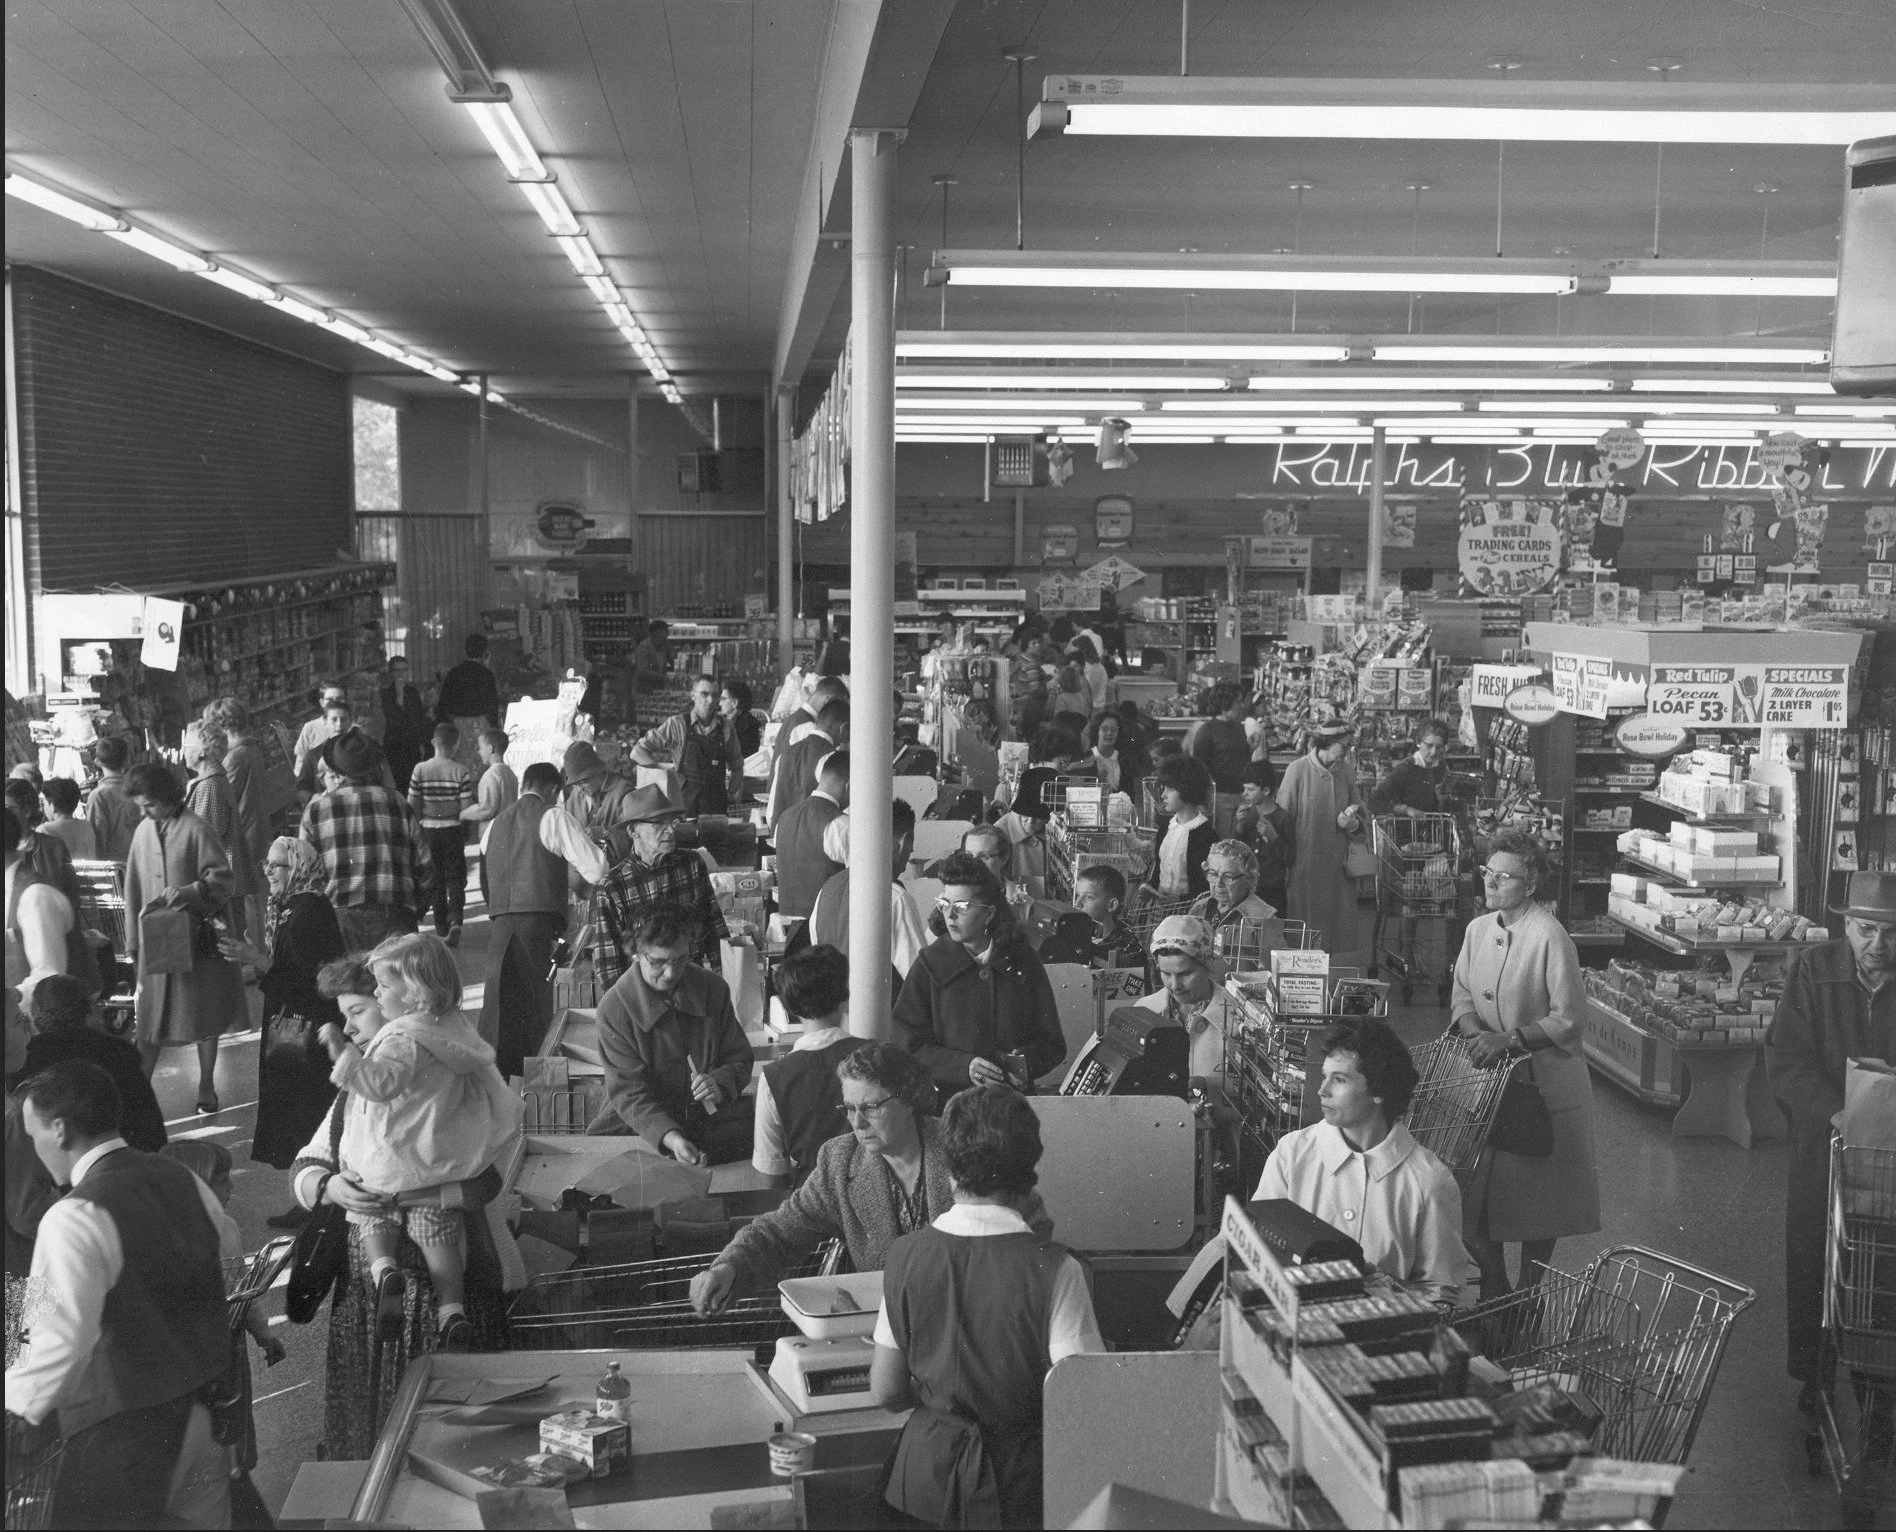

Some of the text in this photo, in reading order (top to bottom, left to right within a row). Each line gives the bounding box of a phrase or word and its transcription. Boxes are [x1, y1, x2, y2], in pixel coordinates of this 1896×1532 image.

[1492, 524, 1532, 538] FREE!
[1467, 539, 1552, 551] TRADING CARDS
[1502, 553, 1550, 563] CEREALS
[1665, 669, 1729, 684] Red Tulip
[1770, 669, 1833, 684] SPECIALS
[1478, 675, 1508, 697] FRESH
[1771, 686, 1842, 699] Milk Chocolate
[1663, 686, 1720, 700] Pecan
[1652, 700, 1695, 715] LOAF
[1768, 700, 1777, 710] 2
[1779, 700, 1812, 711] LAYER
[1766, 711, 1793, 723] CAKE
[1622, 731, 1679, 743] Rose Bowl Holiday
[1291, 955, 1322, 968] Reader's
[1128, 976, 1143, 988] TAKE
[1125, 985, 1138, 995] ONE
[1226, 1213, 1260, 1272] CIGAR
